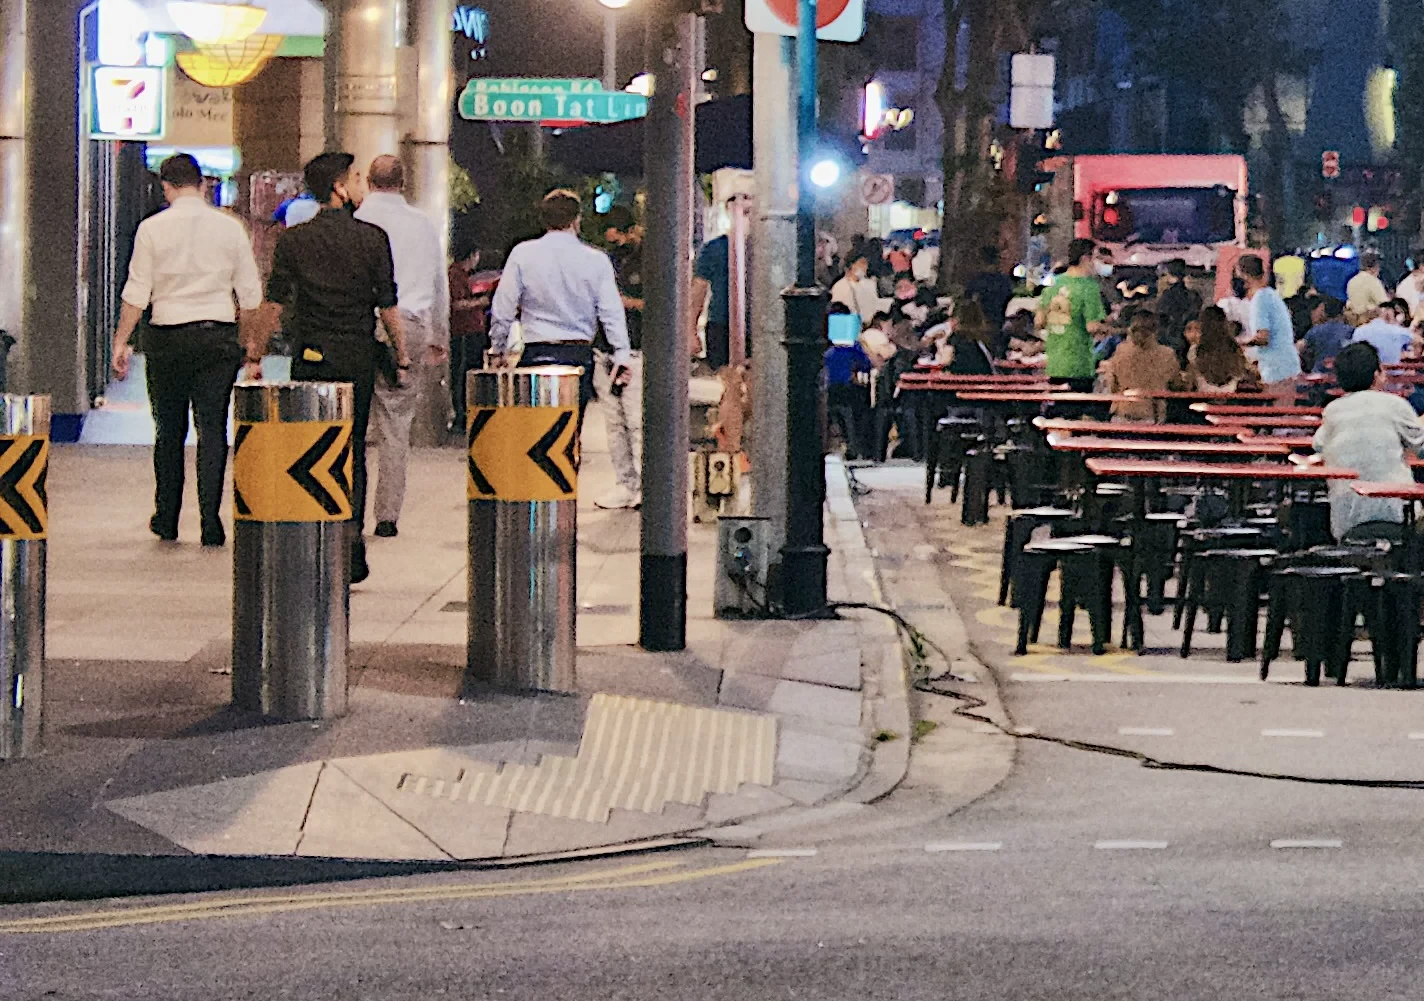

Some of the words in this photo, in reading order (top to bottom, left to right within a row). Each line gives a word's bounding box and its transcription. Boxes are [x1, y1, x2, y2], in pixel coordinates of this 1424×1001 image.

[112, 79, 146, 129] 7
[474, 93, 542, 117] Boon
[555, 92, 595, 118] Tat
[608, 96, 648, 118] Lin
